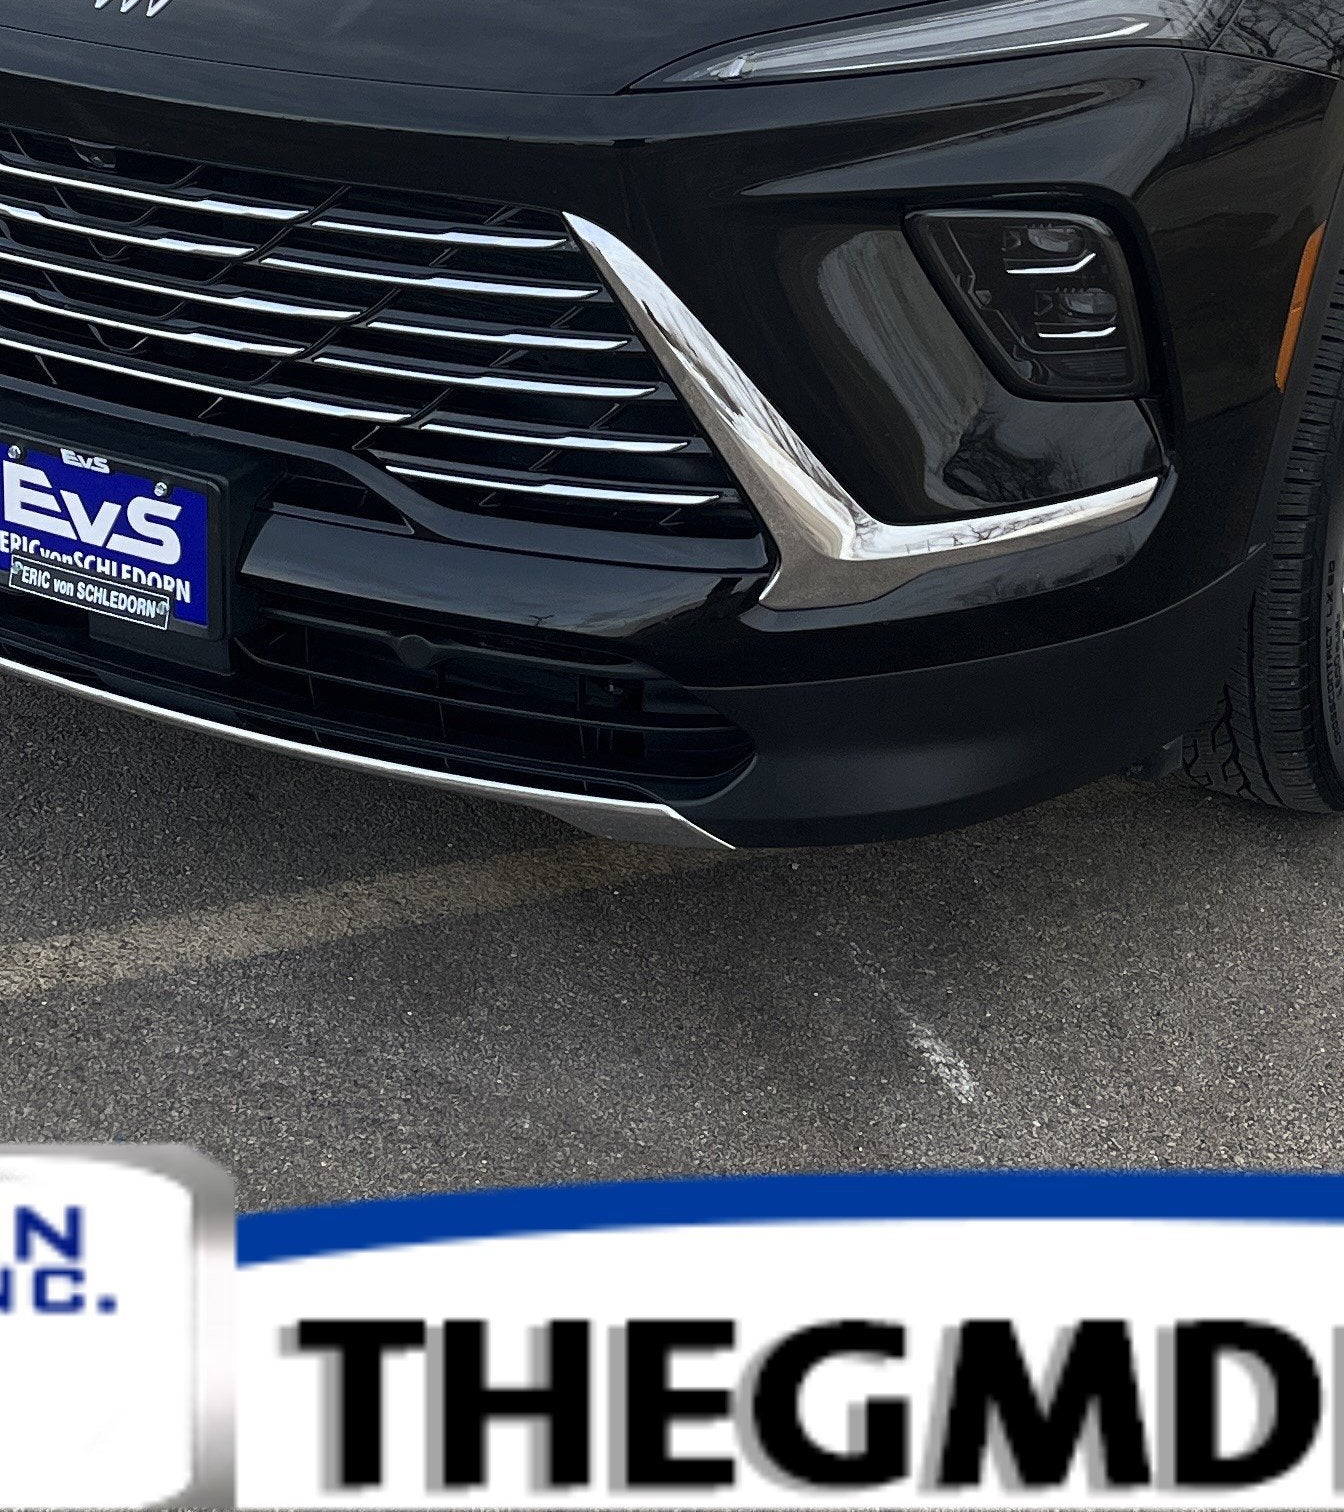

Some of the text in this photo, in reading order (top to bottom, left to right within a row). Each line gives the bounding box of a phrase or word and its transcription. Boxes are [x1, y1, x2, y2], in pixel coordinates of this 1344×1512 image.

[21, 565, 157, 619] ERIC von SCHLEDORN
